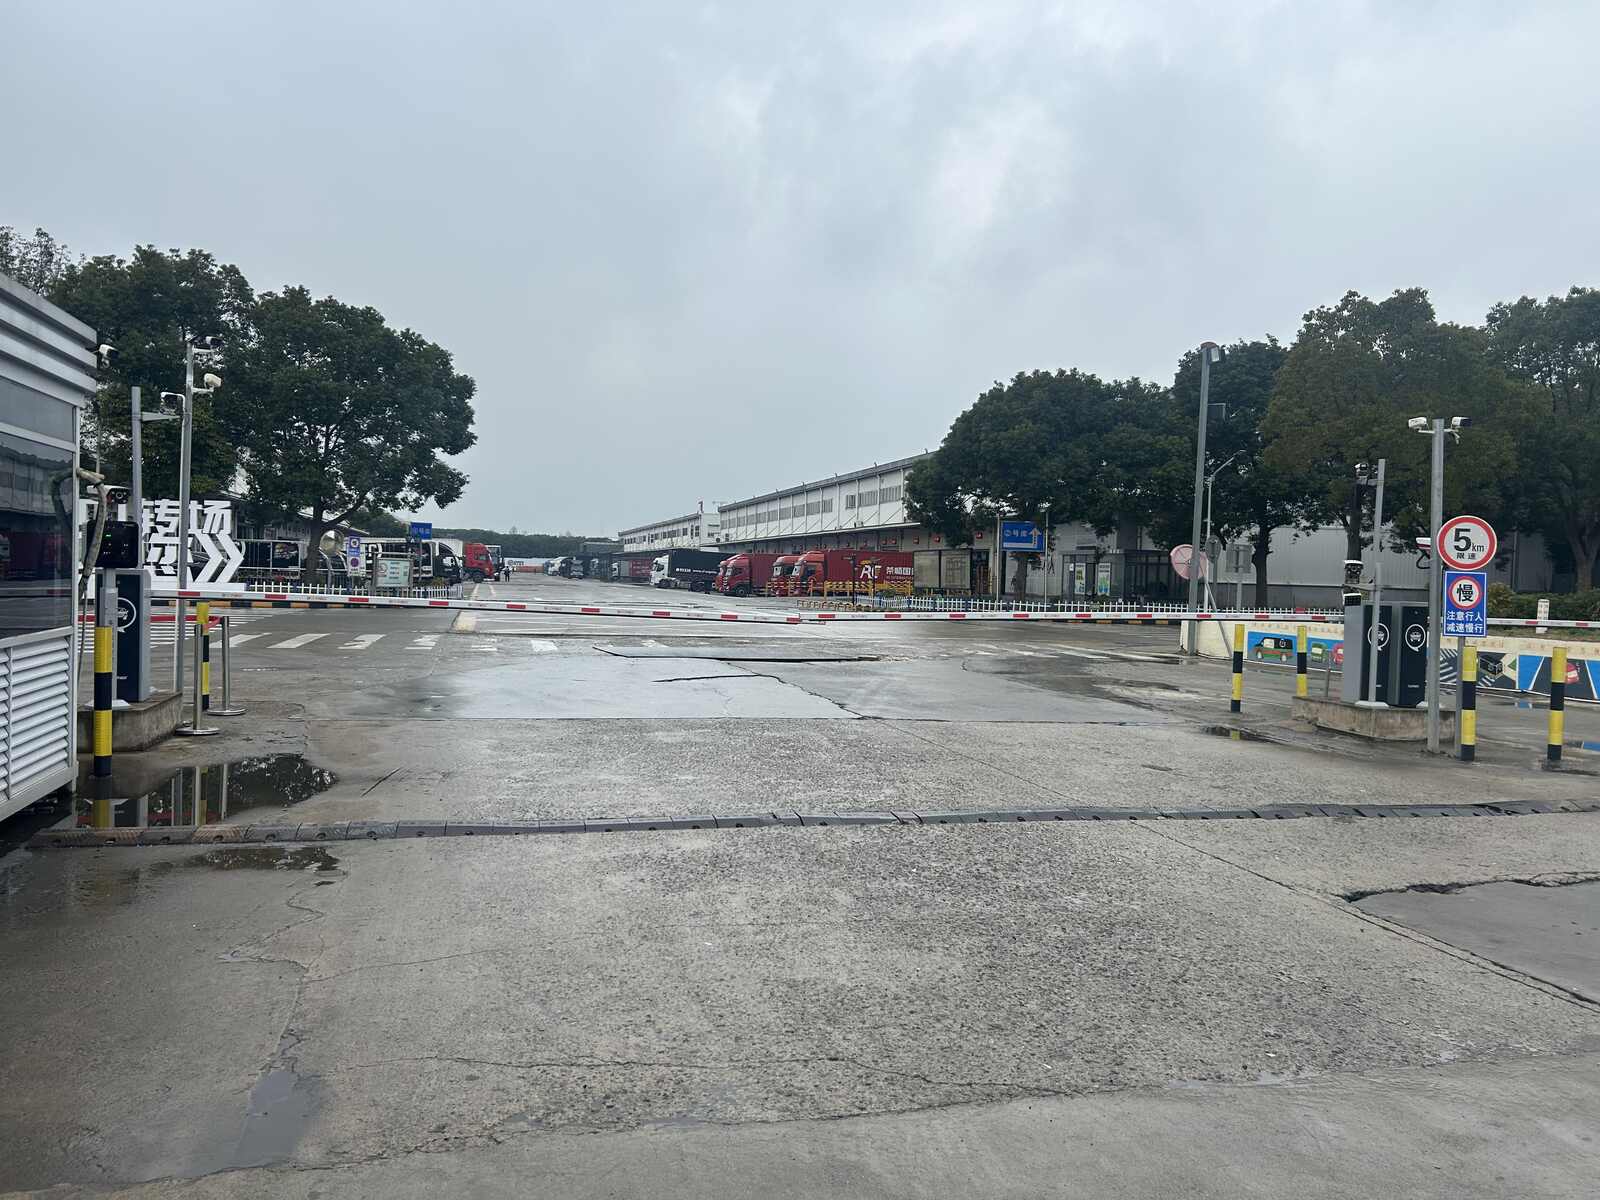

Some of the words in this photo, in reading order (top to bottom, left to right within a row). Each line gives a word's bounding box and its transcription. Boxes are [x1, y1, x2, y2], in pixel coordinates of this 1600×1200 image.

[1456, 552, 1476, 560] 限速
[1457, 584, 1474, 602] 慢
[1446, 610, 1484, 622] 注意行人
[1446, 623, 1484, 633] 减速慢行
